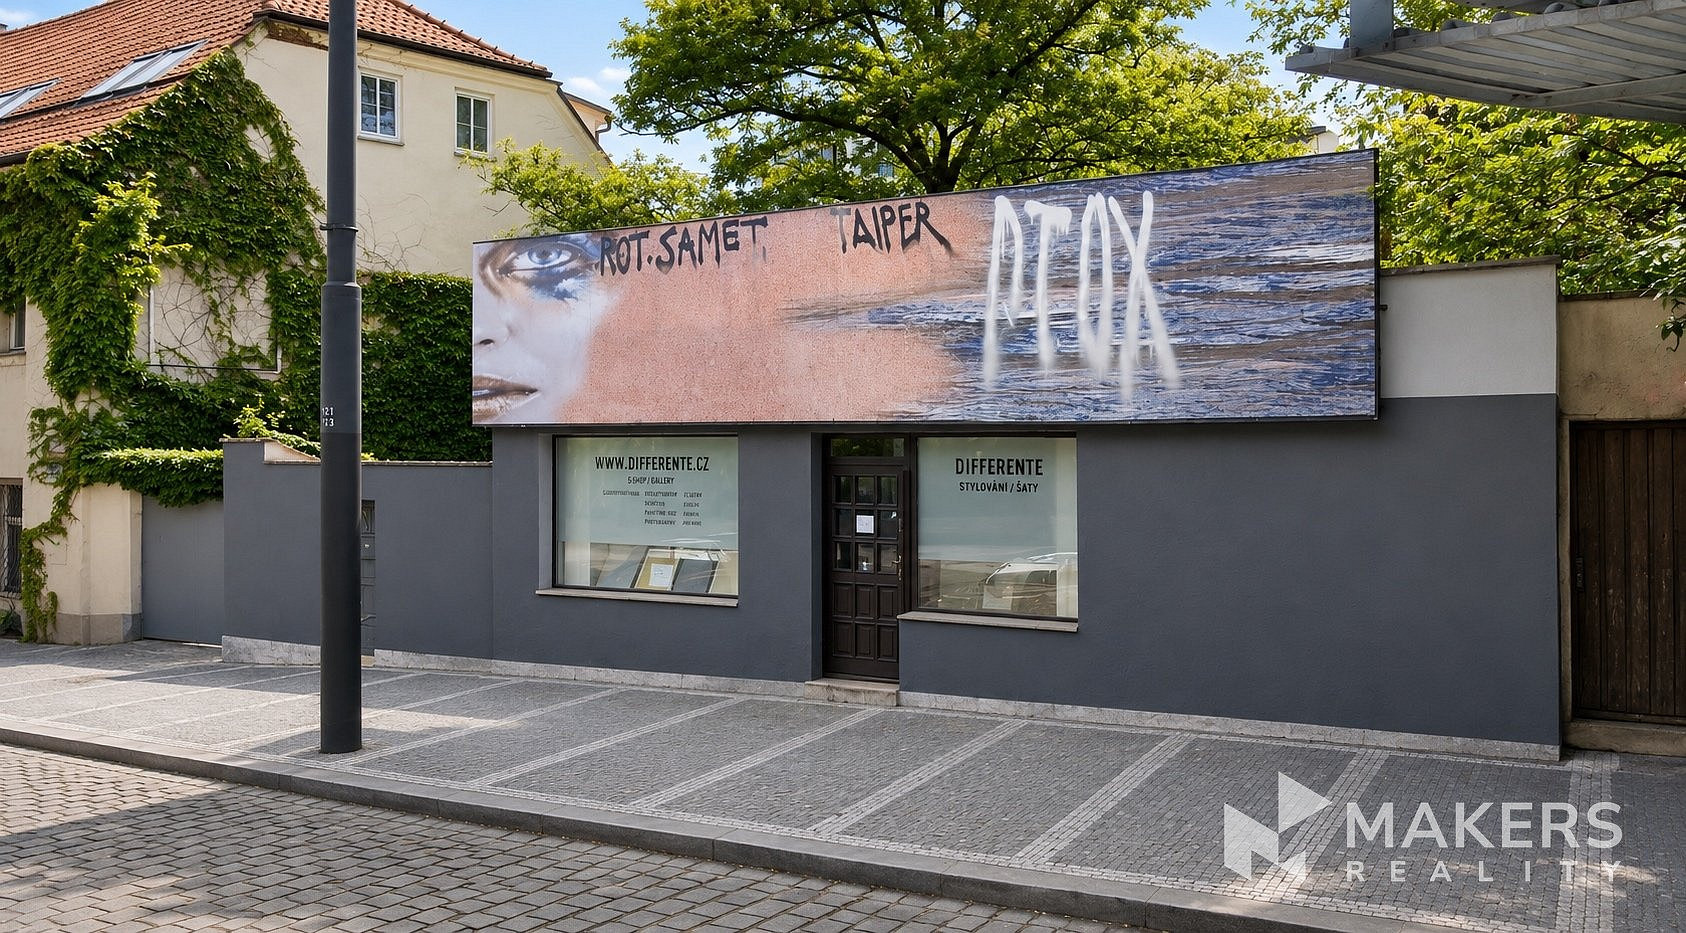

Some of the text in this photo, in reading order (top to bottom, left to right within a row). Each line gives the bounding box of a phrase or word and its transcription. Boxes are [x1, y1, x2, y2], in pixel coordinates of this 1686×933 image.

[595, 456, 709, 471] WWW.DIFFERENTE.CZ
[955, 458, 1044, 476] DIFFERENTE
[1016, 481, 1039, 493] ŠATY
